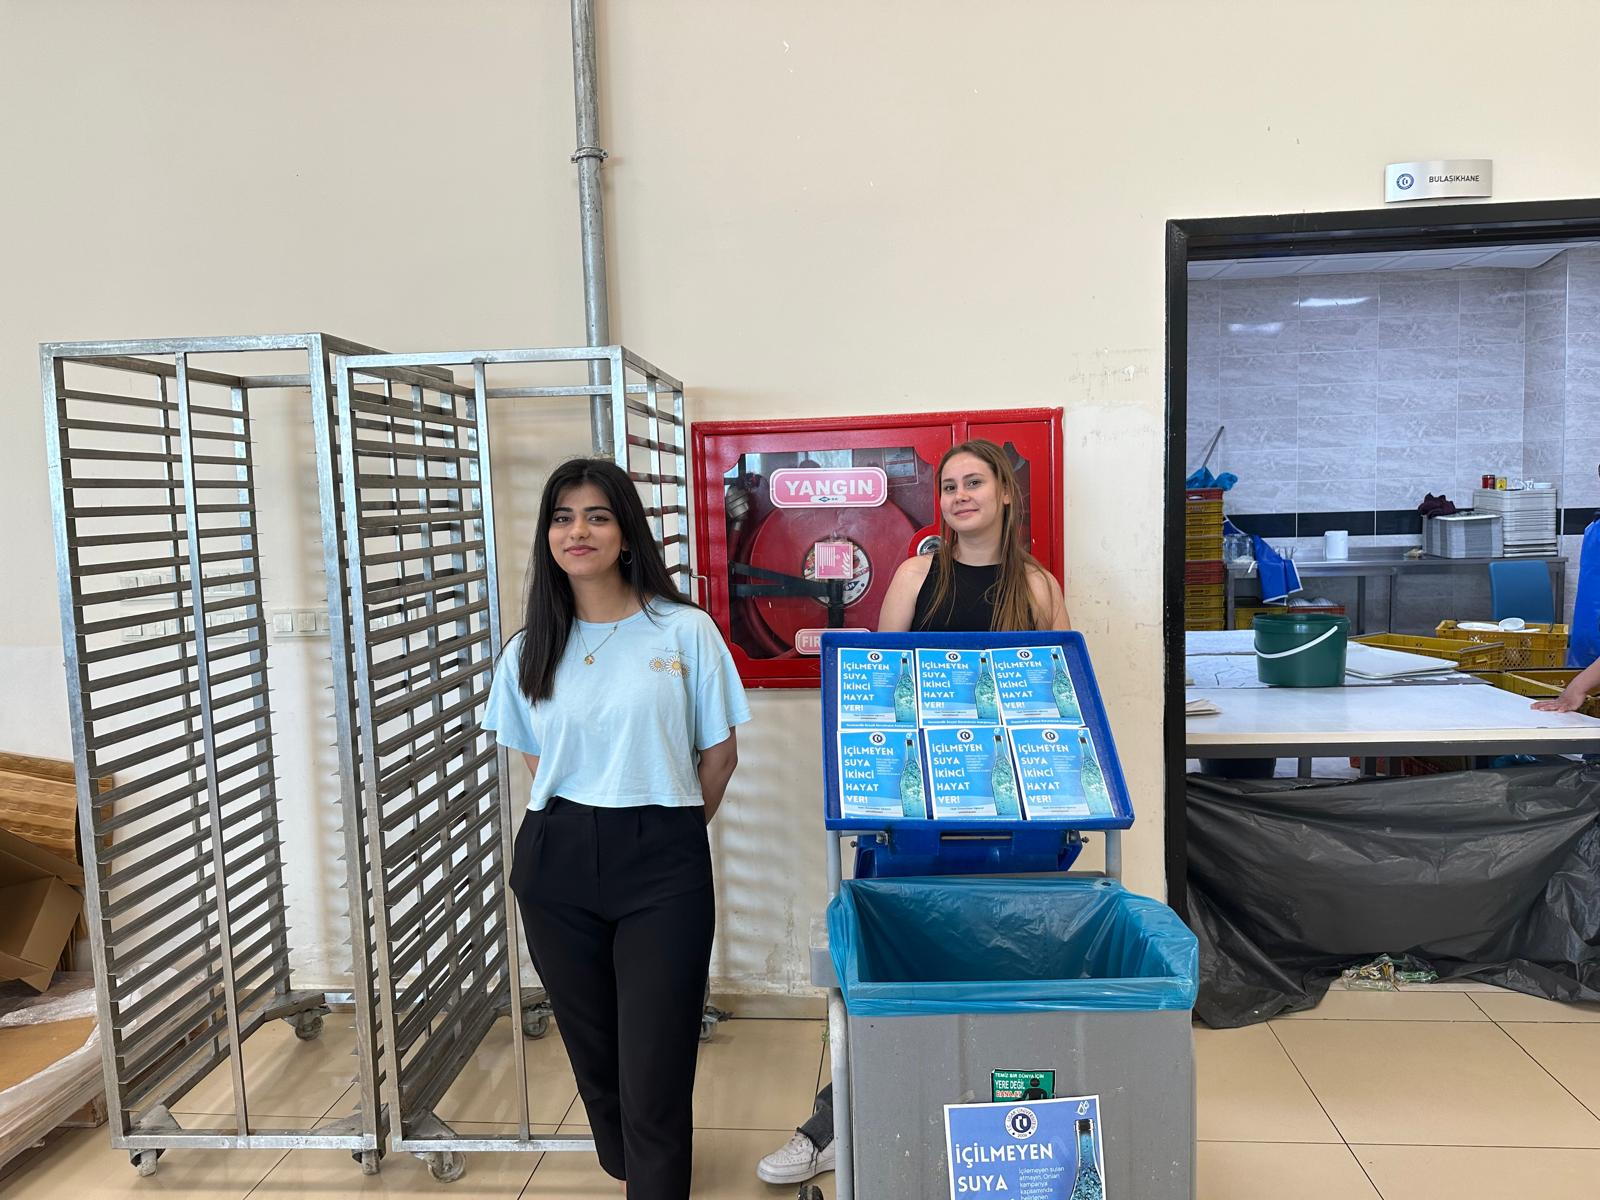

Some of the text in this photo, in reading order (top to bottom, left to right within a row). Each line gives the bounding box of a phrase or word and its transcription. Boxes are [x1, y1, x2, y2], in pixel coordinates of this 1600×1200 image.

[1429, 175, 1480, 183] BULAŞIKHANE
[784, 479, 873, 496] YANGIN
[802, 636, 821, 647] FIR
[843, 662, 890, 671] İÇİLMEYEN
[921, 661, 969, 670] İÇİLMEYEN
[994, 661, 1042, 670] İÇİLMEYEN
[997, 671, 1022, 679] SUYA
[843, 682, 871, 690] İKİNCİ
[923, 680, 951, 688] İKİNCİ
[1000, 679, 1028, 688] İKİNCİ
[1001, 690, 1033, 699] HAYAT
[844, 746, 894, 757] İÇİLMEYEN
[932, 743, 983, 755] İÇİLMEYEN
[1018, 743, 1070, 755] İÇİLMEYEN
[844, 759, 870, 767] SUYA
[933, 757, 960, 765] SUYA
[1021, 757, 1048, 765] SUYA
[845, 769, 874, 779] İKİNCİ
[935, 767, 965, 778] İKİNCİ
[1023, 767, 1054, 778] İKİNCİ
[845, 783, 879, 792] HAYAT
[936, 782, 970, 791] HAYAT
[1026, 782, 1060, 791] HAYAT
[995, 1080, 1009, 1089] YERE
[955, 1142, 1053, 1168] İÇİLMEYEN
[957, 1174, 1008, 1193] SUYA
